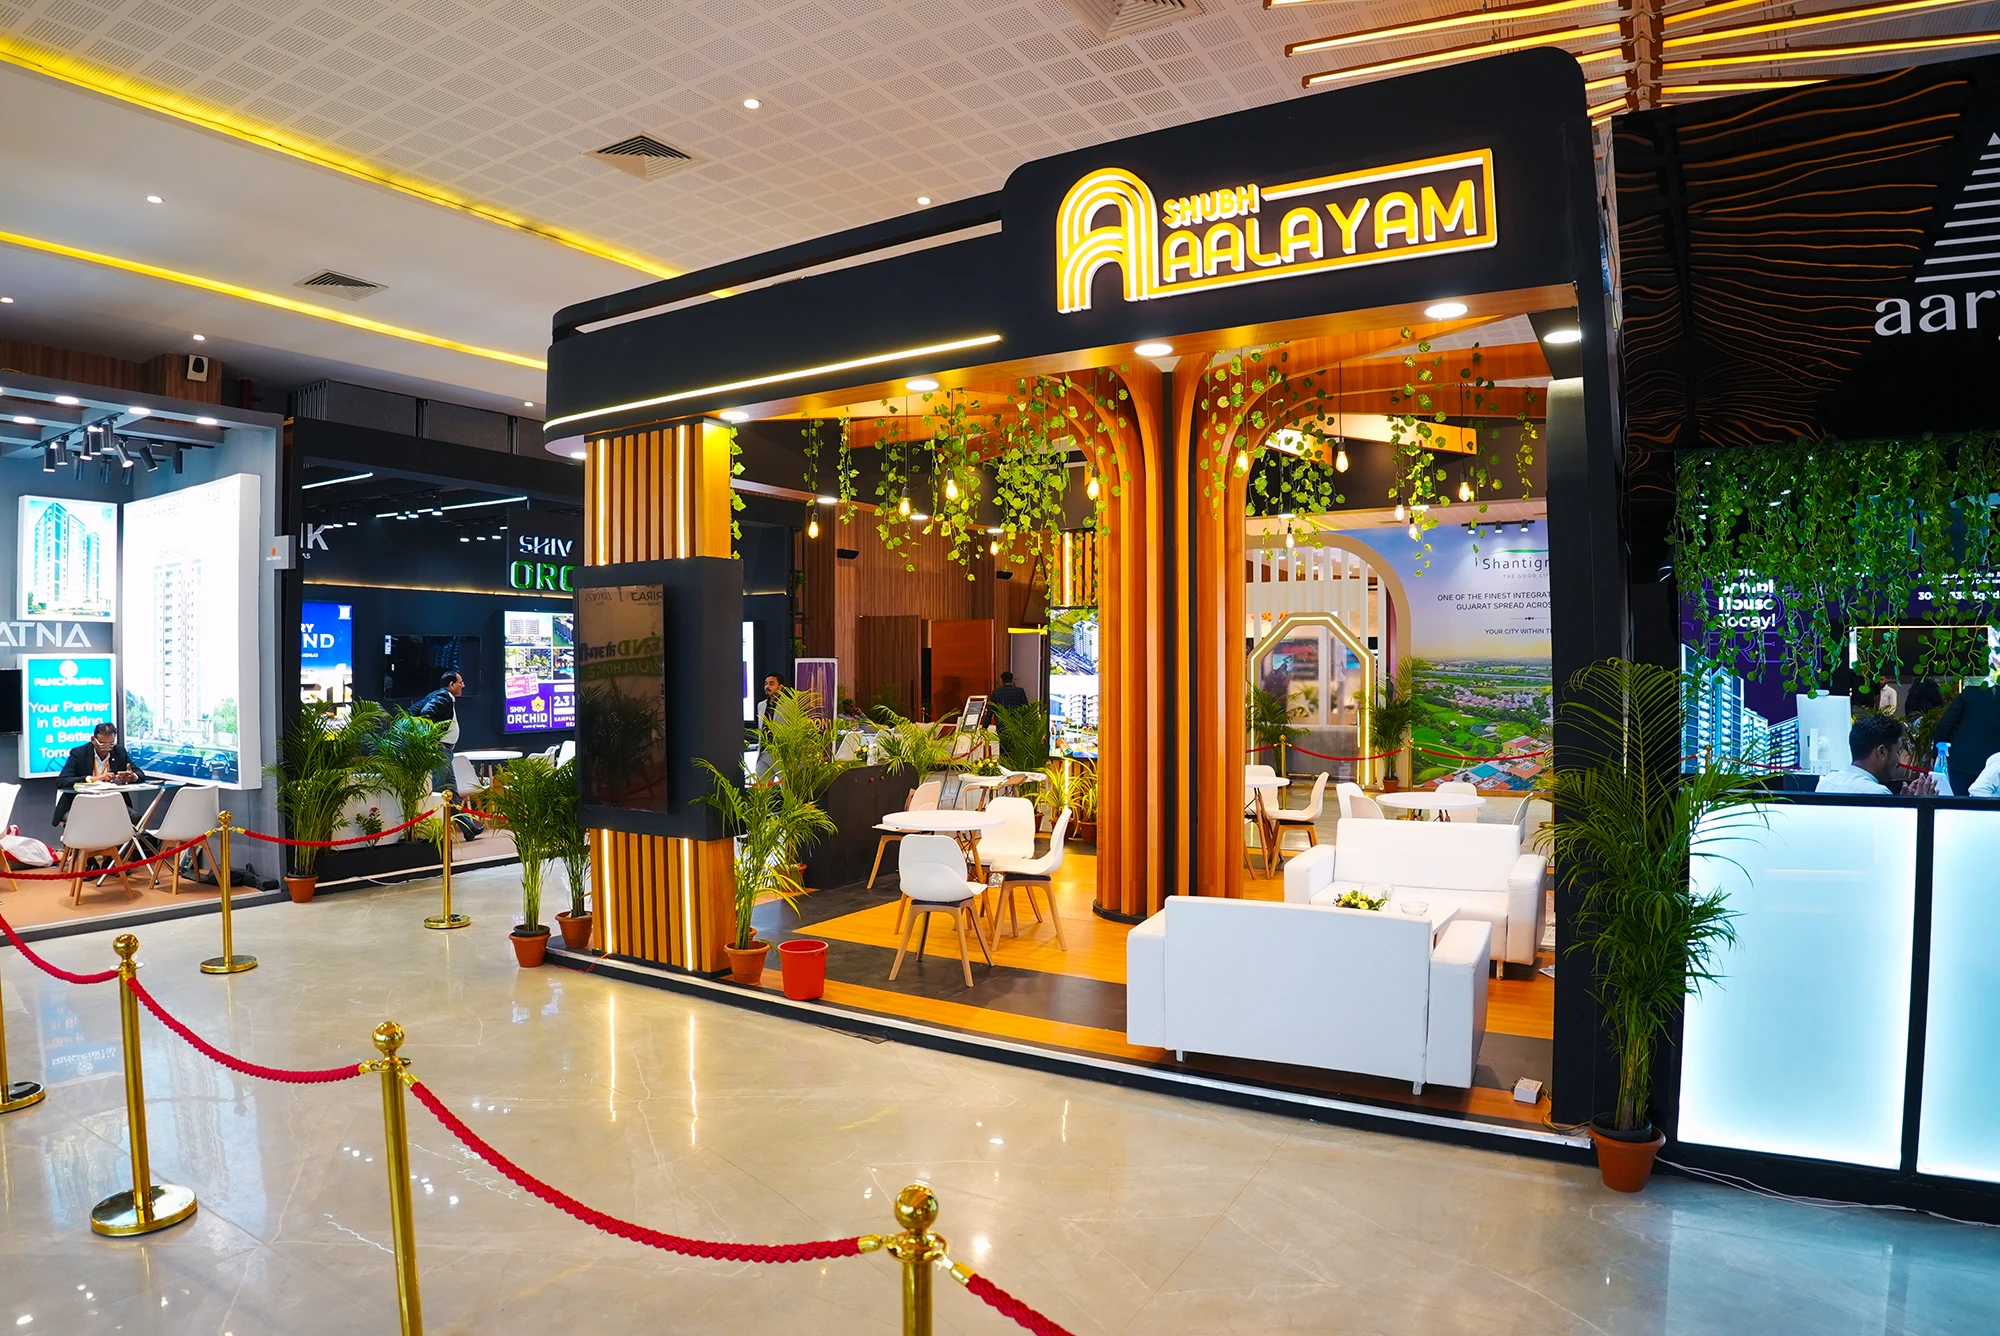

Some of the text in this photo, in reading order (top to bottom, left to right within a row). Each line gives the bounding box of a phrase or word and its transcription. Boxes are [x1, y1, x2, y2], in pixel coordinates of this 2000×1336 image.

[1162, 183, 1260, 228] SHUBH
[1162, 179, 1477, 283] AALAYAM
[1875, 289, 2000, 336] aar
[519, 535, 573, 557] SHIV
[1484, 592, 1511, 600] FINEST
[1456, 603, 1492, 611] GUJARAT
[29, 701, 110, 713] Your Partner
[37, 717, 48, 728] in
[507, 713, 548, 724] ORCHID
[45, 734, 54, 743] a
